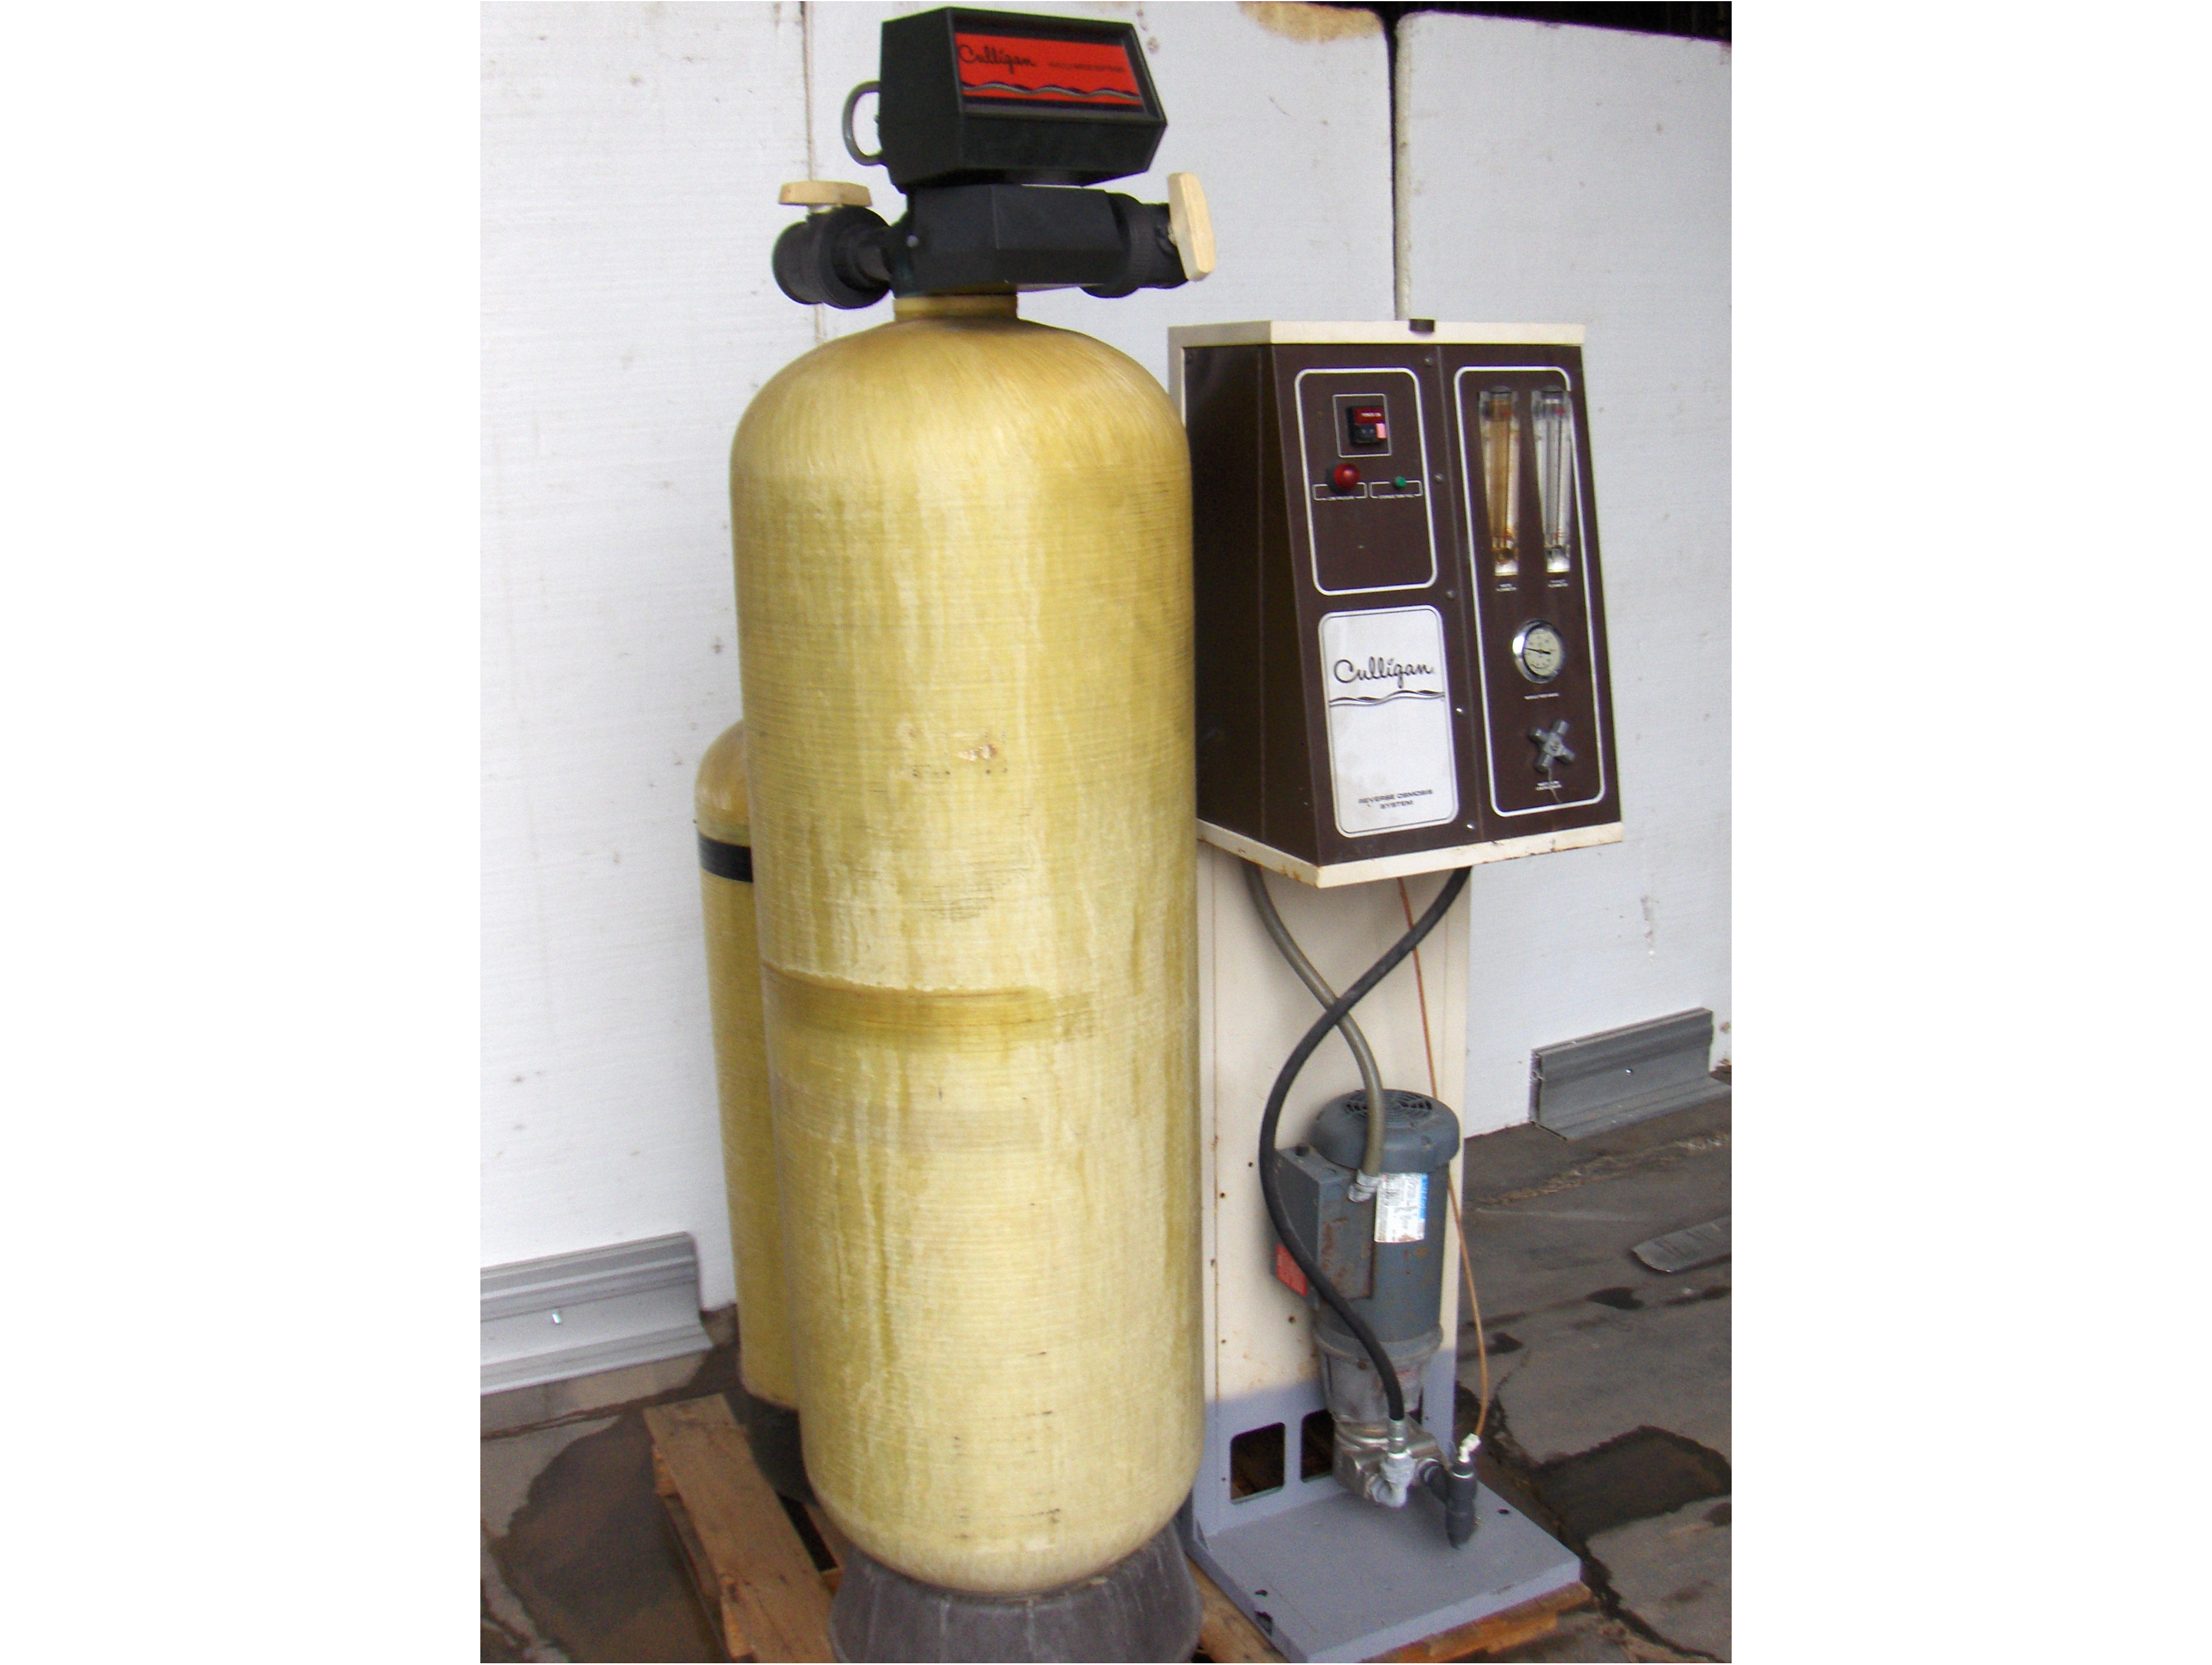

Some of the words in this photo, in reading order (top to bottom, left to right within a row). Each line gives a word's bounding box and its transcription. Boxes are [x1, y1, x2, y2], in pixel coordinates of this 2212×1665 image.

[958, 44, 1035, 74] Culligan
[1334, 656, 1433, 689] Culligan
[1358, 794, 1395, 804] REVERSE
[1397, 789, 1433, 798] OSMOSIS
[1380, 800, 1413, 809] SYSTEM
